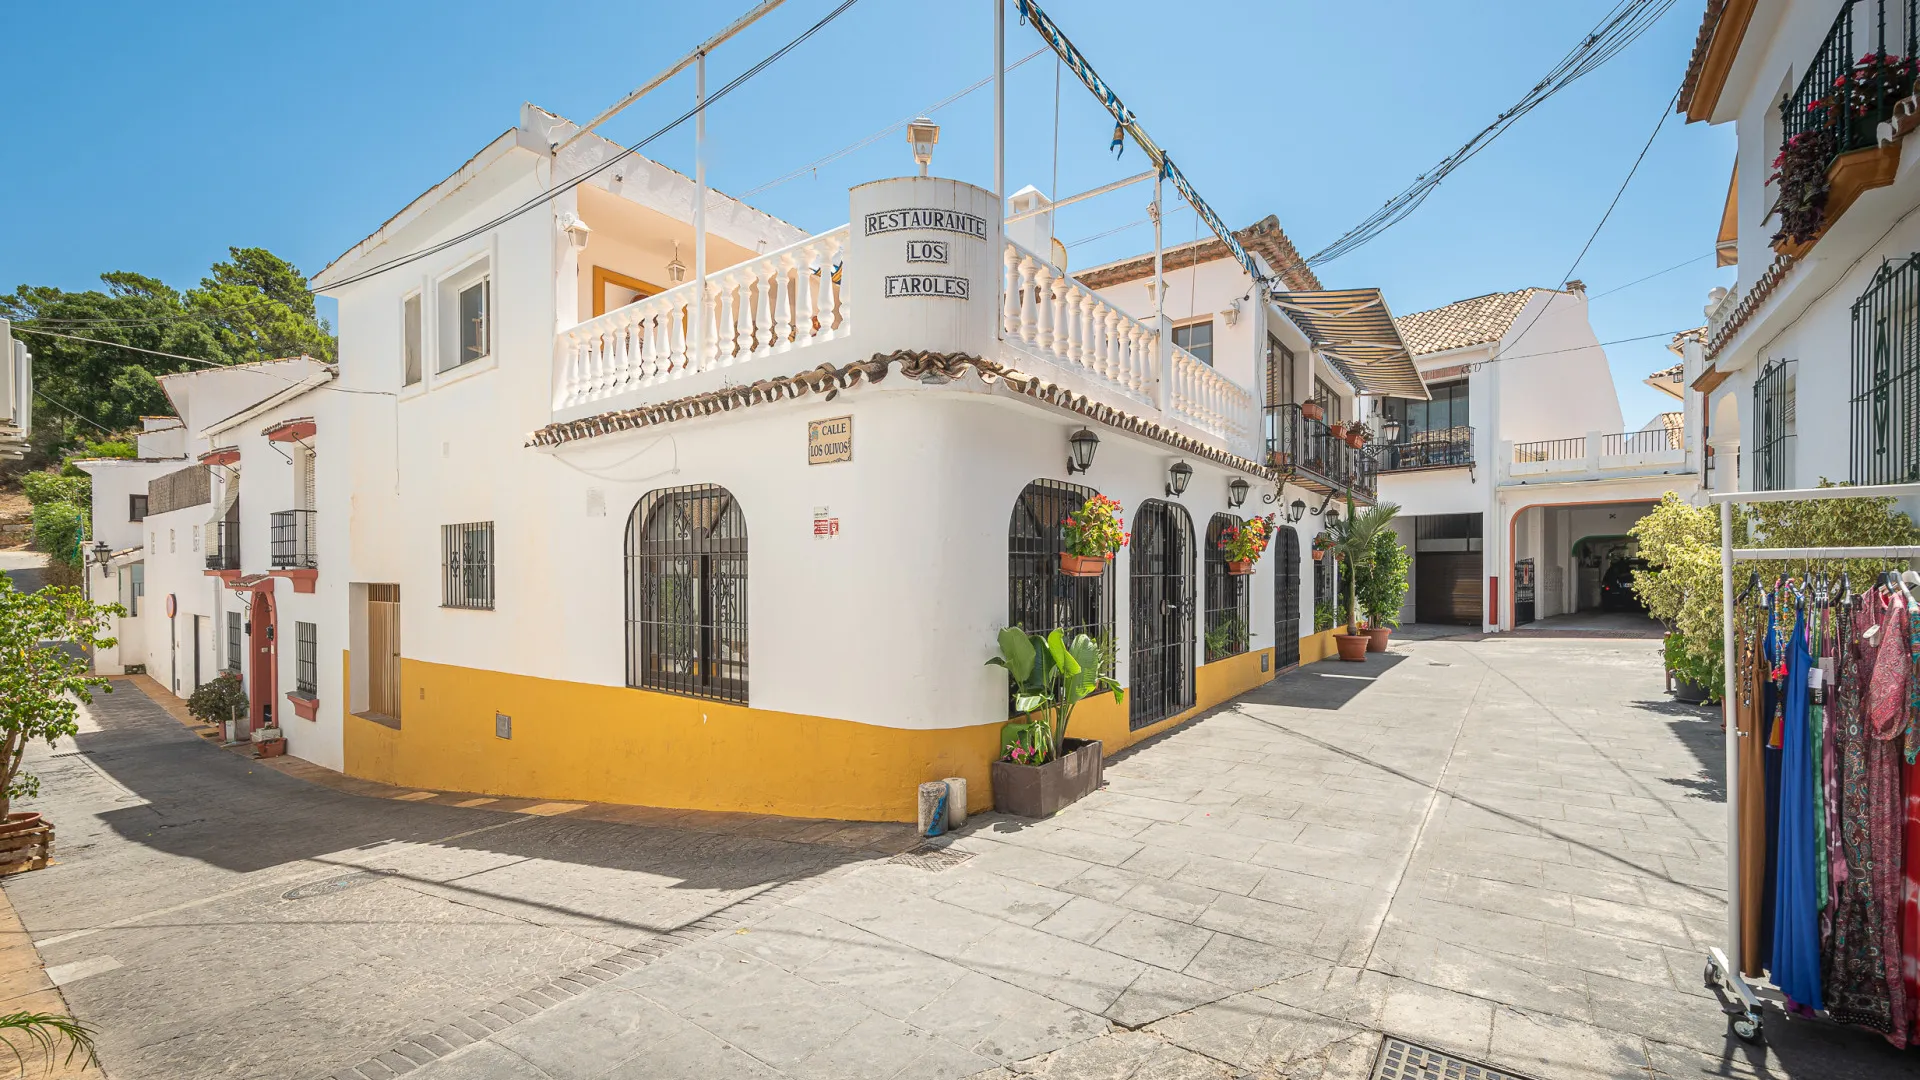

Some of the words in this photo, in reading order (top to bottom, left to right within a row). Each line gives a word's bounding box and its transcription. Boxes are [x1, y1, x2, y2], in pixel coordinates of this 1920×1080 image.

[867, 211, 985, 236] RESTAURANTE
[911, 244, 944, 260] LOS
[889, 278, 966, 295] FAROLES
[822, 423, 847, 436] CALLE
[811, 444, 823, 457] LOS
[824, 441, 848, 456] OLIVOS
